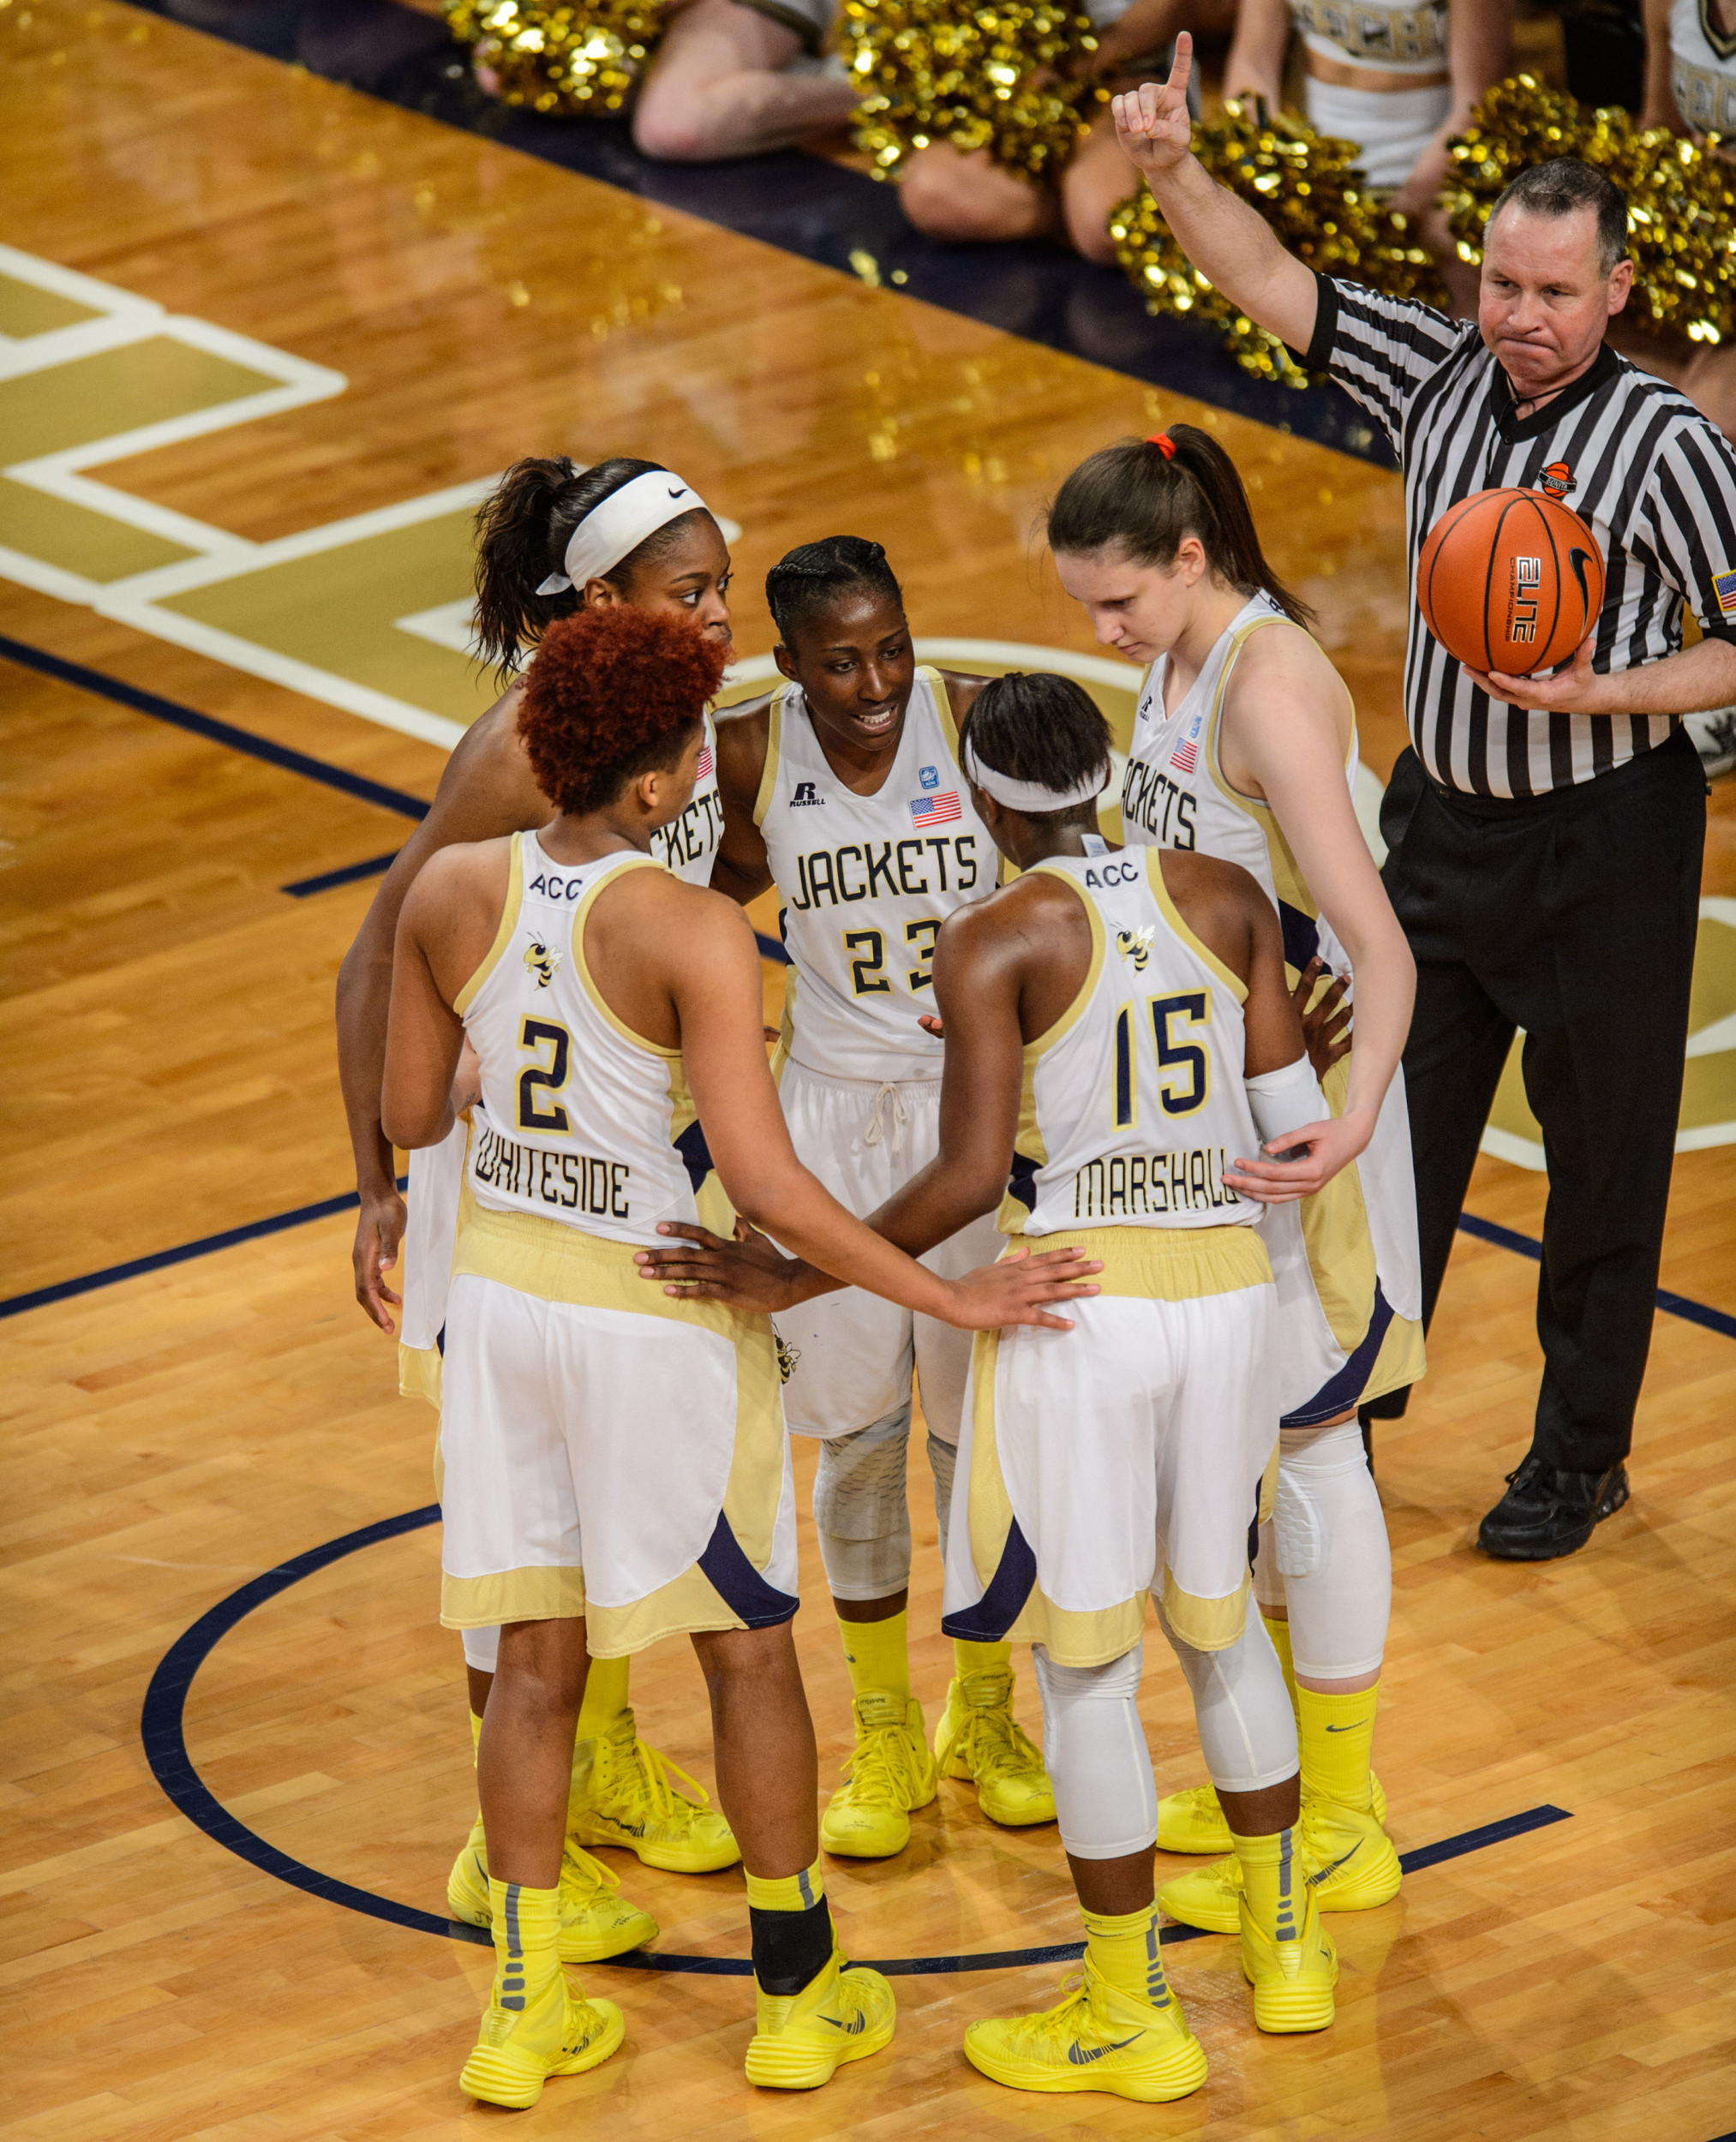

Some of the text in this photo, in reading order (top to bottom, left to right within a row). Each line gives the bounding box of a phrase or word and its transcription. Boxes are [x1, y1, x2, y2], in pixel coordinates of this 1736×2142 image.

[1505, 557, 1516, 642] CHAMPIONSHIP
[1511, 556, 1541, 643] ELITE
[789, 799, 826, 808] RUSSELL
[528, 873, 584, 900] ACC
[791, 835, 977, 911] JACKETS
[1085, 862, 1139, 889] ACC
[841, 916, 944, 999] 23
[517, 1012, 573, 1137] 2
[1111, 987, 1212, 1134] 15
[475, 1126, 630, 1219] WHITESIDE
[1074, 1146, 1242, 1218] MARSHALL
